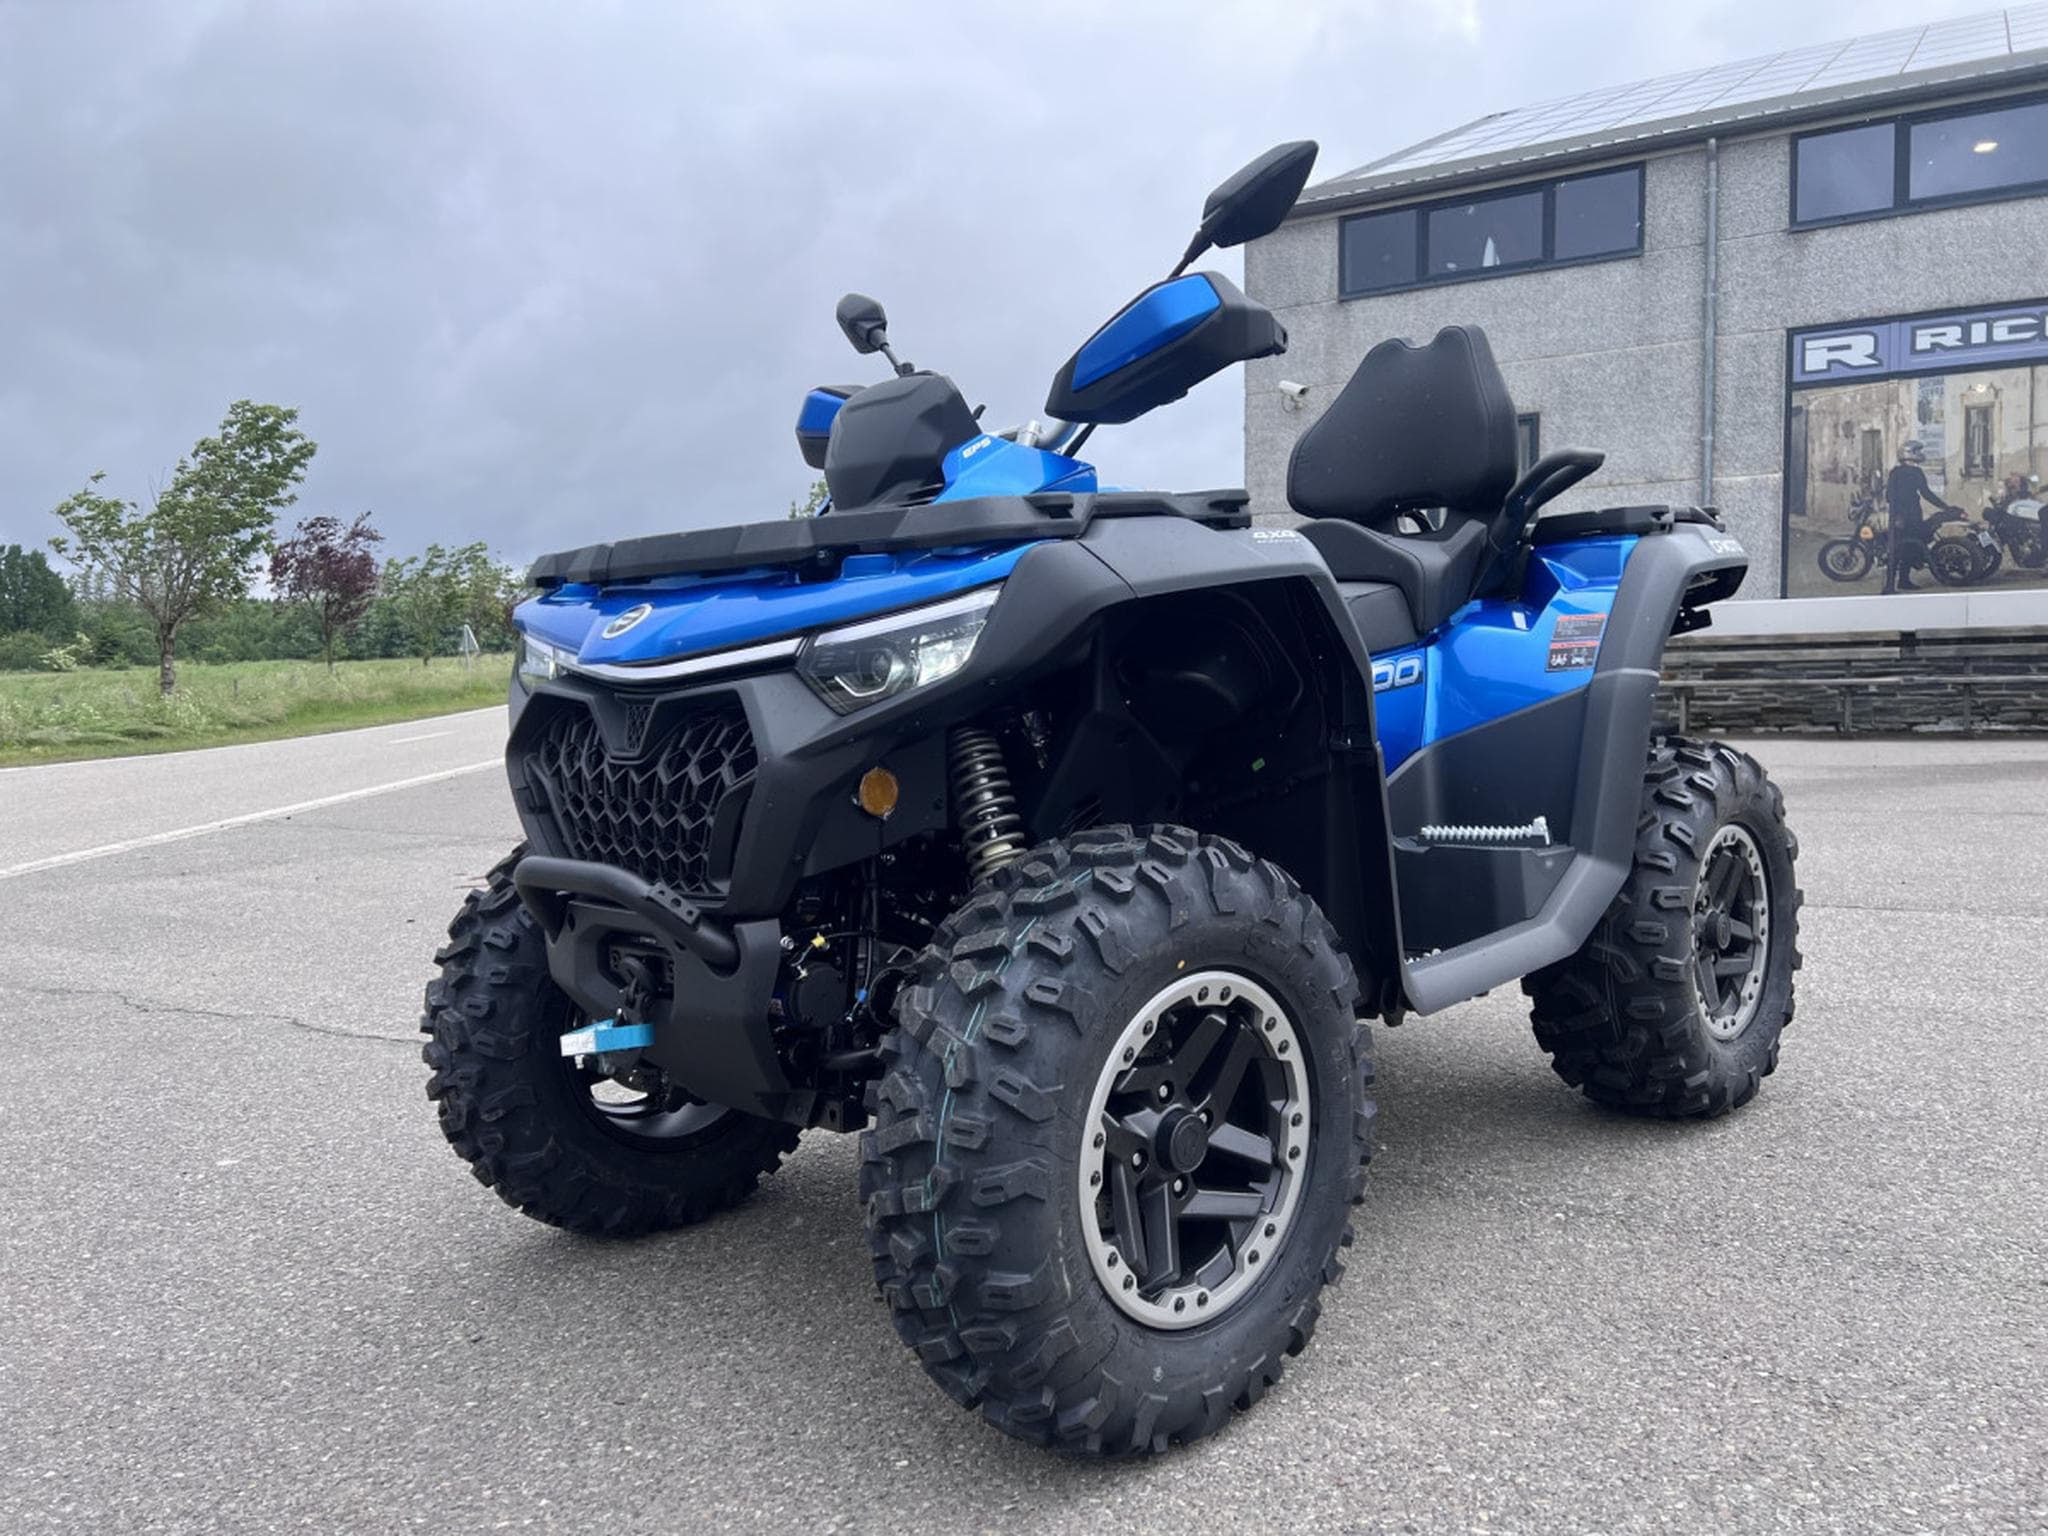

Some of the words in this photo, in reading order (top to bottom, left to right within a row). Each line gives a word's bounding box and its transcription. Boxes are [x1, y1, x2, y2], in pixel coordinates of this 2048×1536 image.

[1804, 333, 1880, 372] R
[1914, 314, 2048, 351] RIC
[962, 437, 992, 459] EPS
